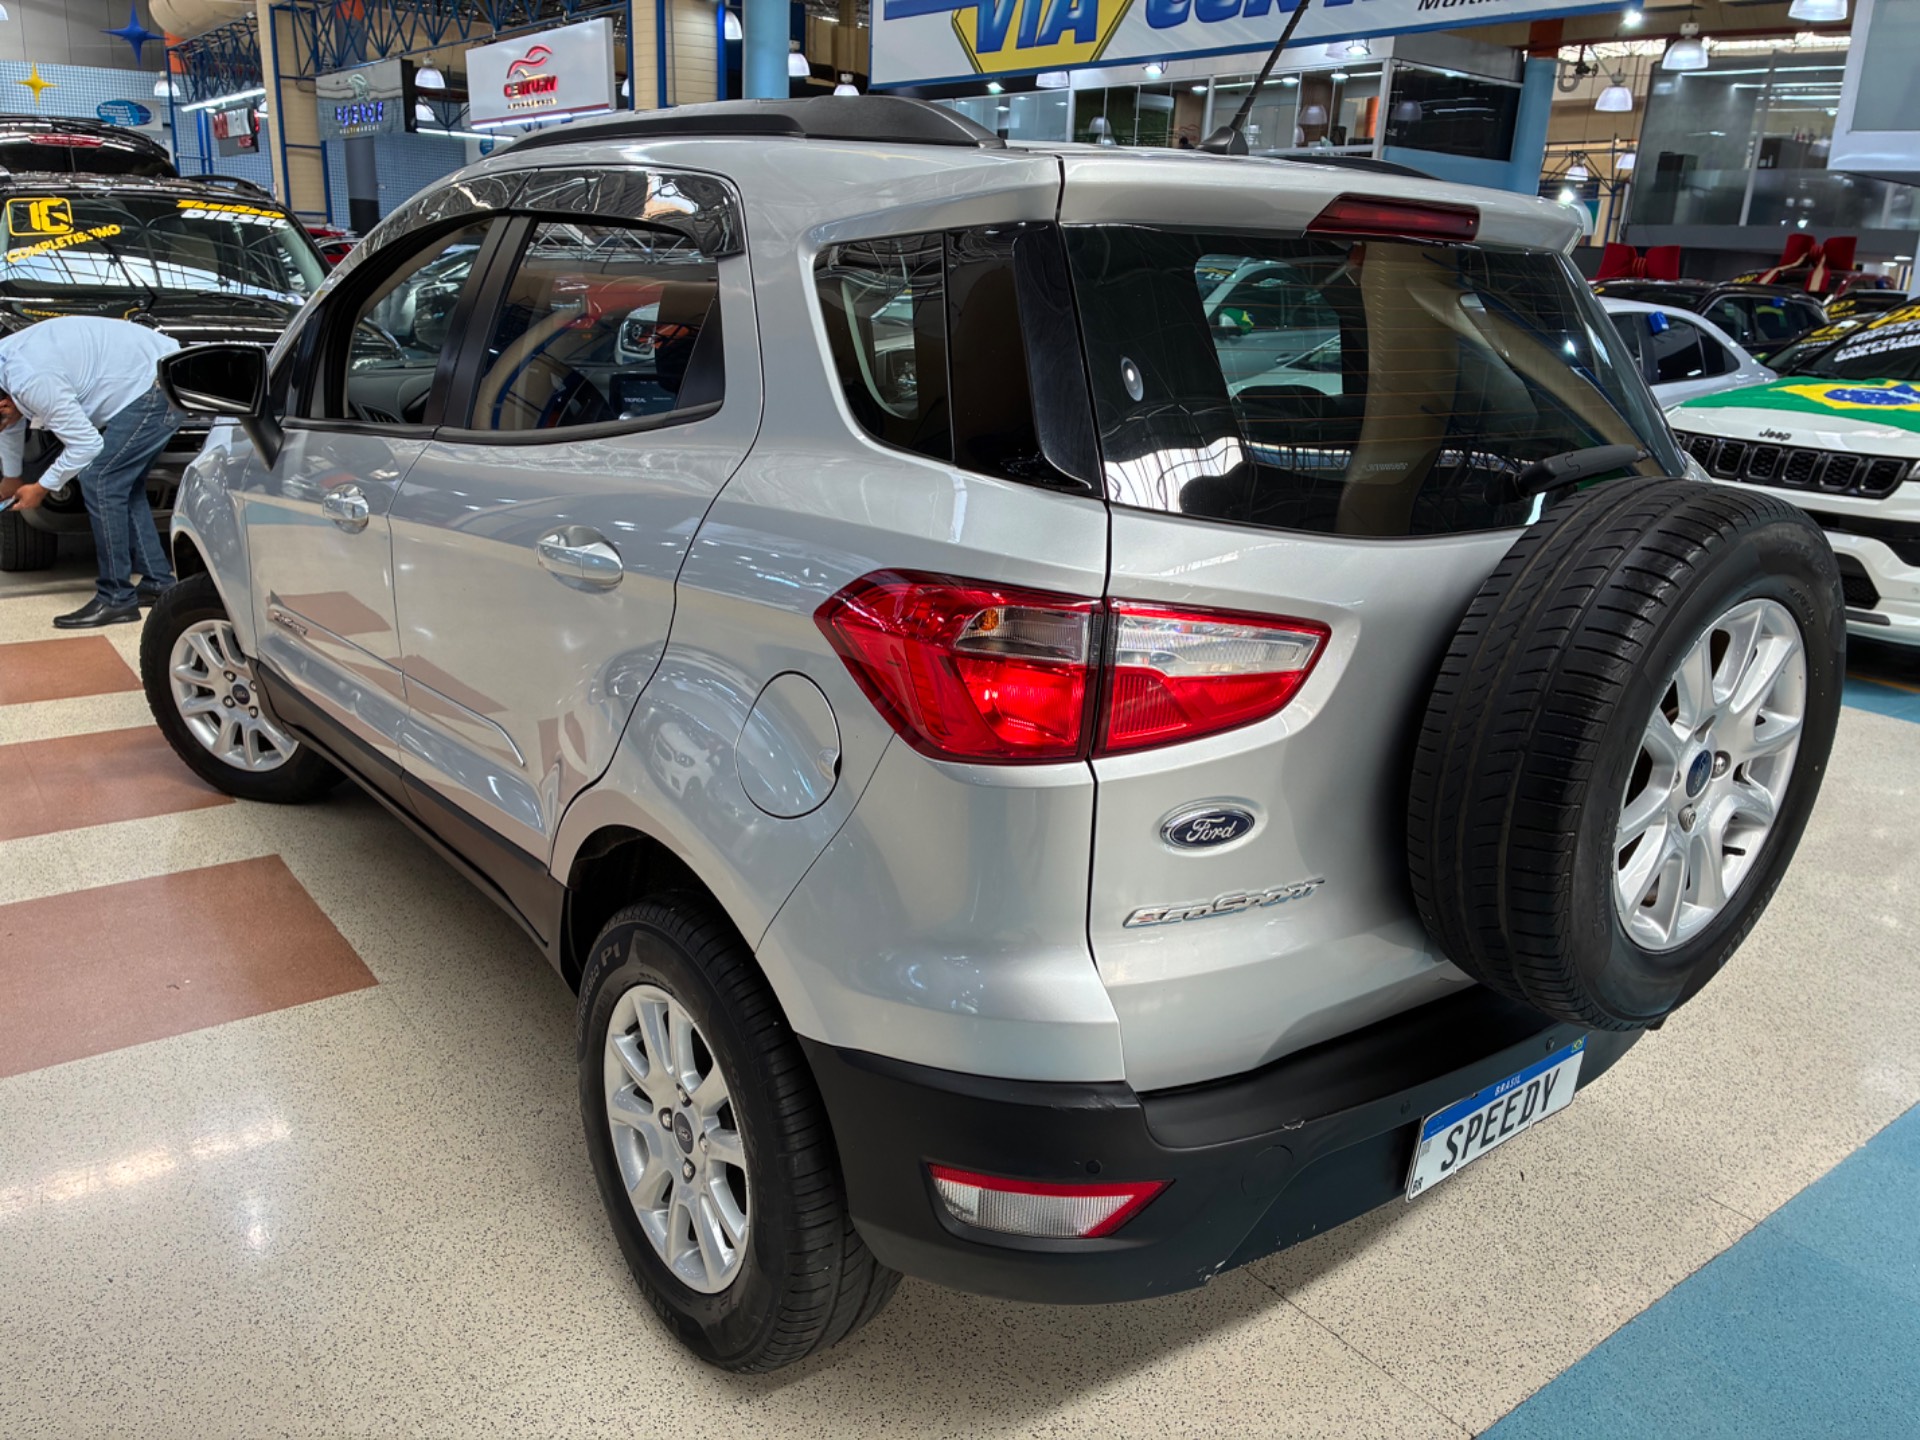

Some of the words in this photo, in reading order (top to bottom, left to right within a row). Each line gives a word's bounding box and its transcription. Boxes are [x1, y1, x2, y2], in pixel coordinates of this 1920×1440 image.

[503, 76, 558, 98] CENTURY
[180, 208, 289, 229] DIESEL
[1758, 428, 1792, 442] Jeep
[1186, 816, 1236, 842] Ford
[1122, 876, 1326, 929] EcoSport
[1494, 1073, 1522, 1097] BRASIL
[1441, 1068, 1561, 1172] SPEEDY
